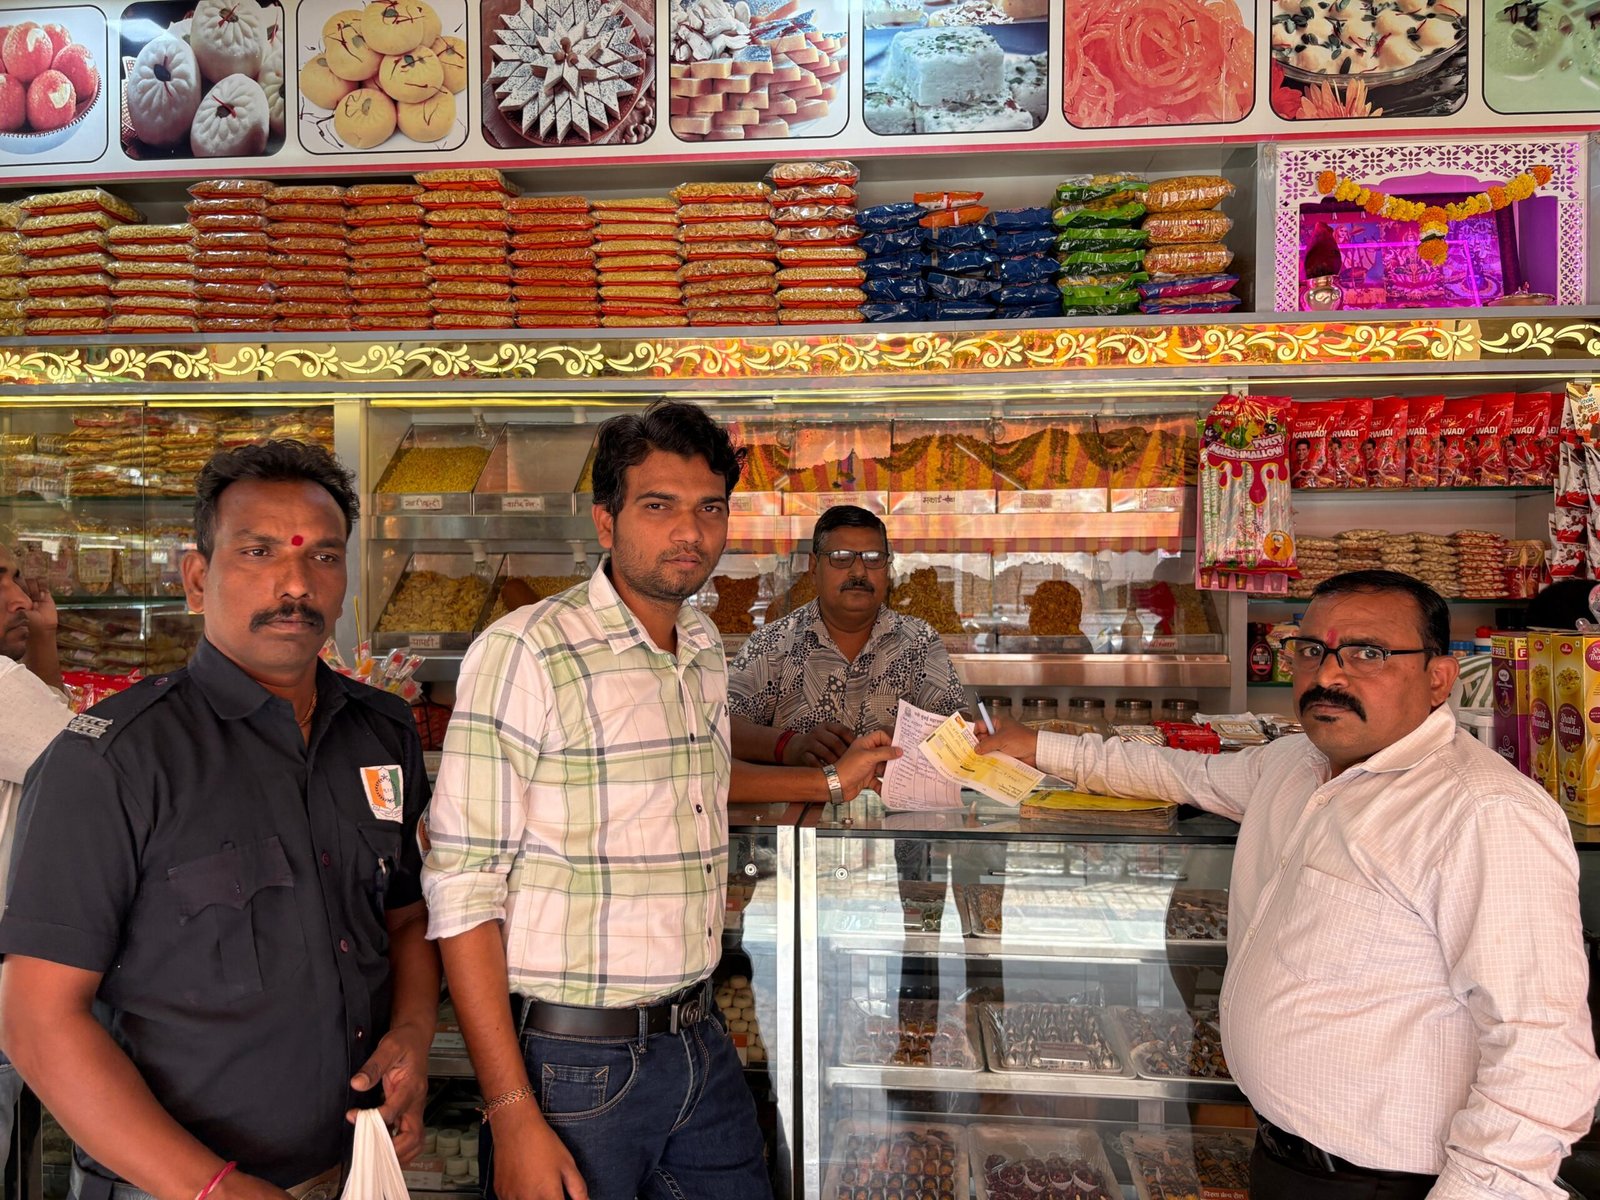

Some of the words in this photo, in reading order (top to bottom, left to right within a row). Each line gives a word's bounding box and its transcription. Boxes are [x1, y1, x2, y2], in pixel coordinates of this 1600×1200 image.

[1253, 433, 1283, 449] TWIST
[1208, 443, 1283, 460] MARSHMALLOW
[1492, 646, 1506, 656] FREE
[1560, 713, 1576, 725] Shahi
[1559, 721, 1581, 736] Thandai
